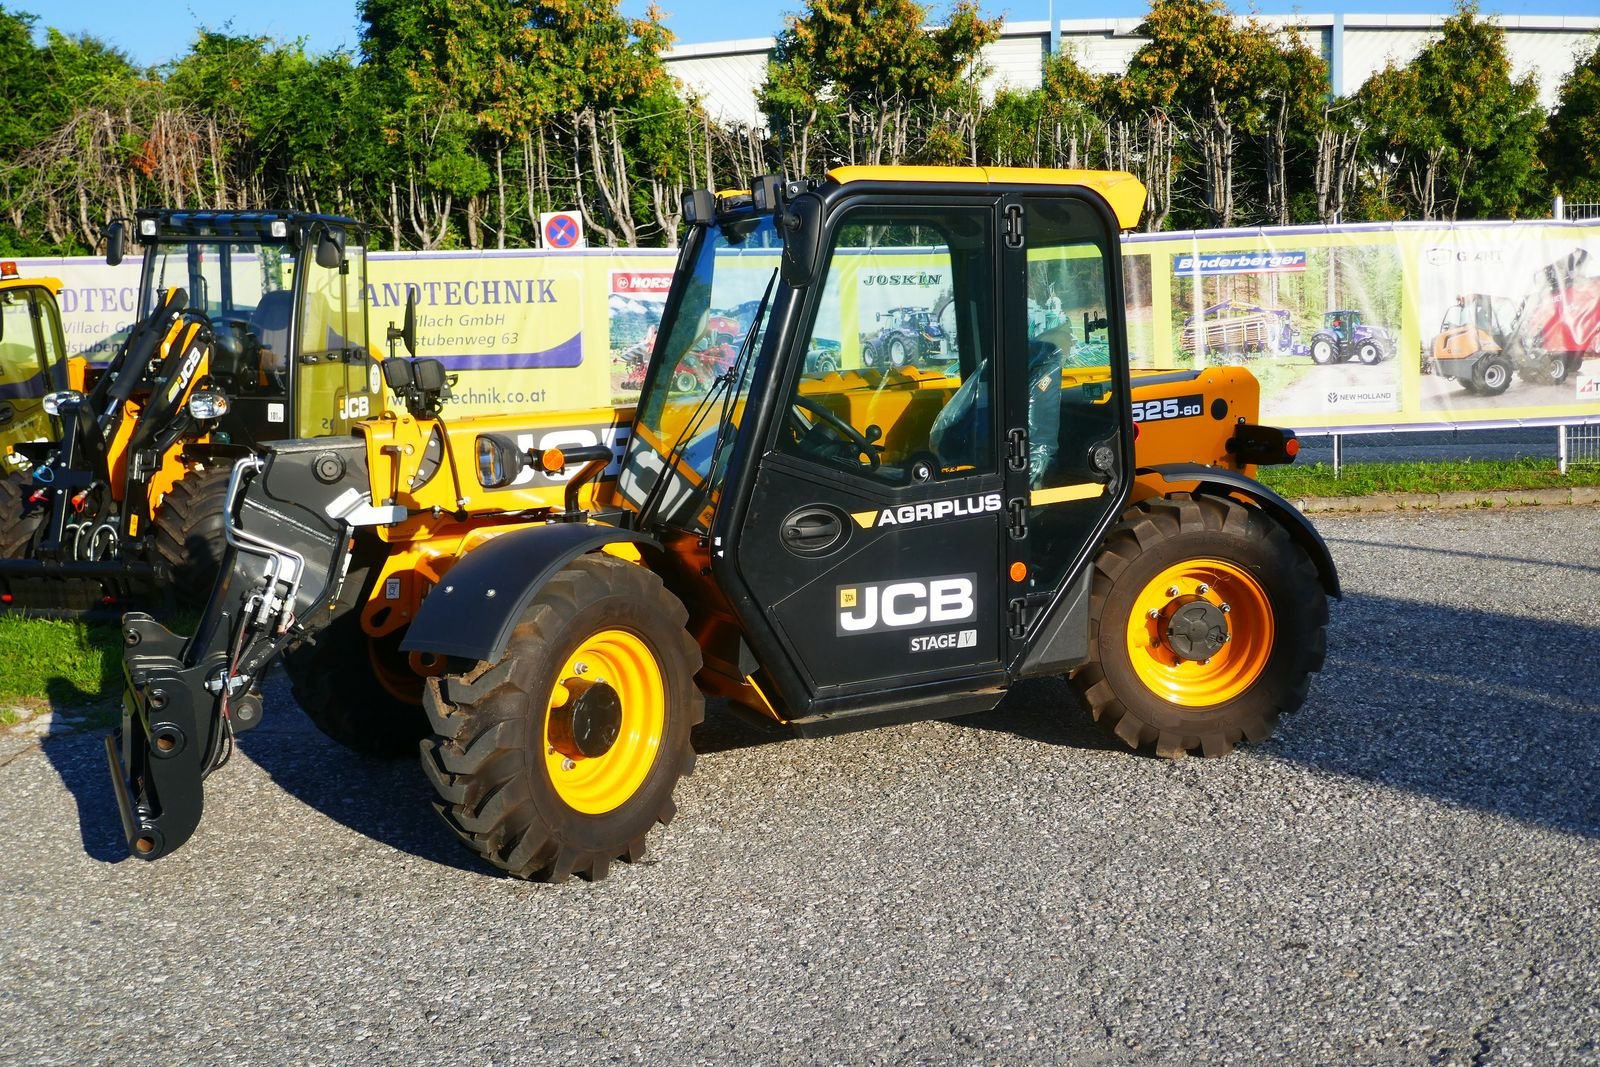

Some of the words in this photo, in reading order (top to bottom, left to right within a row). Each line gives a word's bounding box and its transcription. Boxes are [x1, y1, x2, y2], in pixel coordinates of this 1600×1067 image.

[1178, 255, 1304, 269] Binderberger
[630, 276, 672, 289] HORS
[863, 273, 942, 286] JOSKIN
[365, 278, 558, 308] ANDTECHNIK
[63, 320, 109, 334] Villach
[412, 314, 454, 329] illach
[458, 313, 506, 328] GmbH
[385, 336, 496, 349] astubenweg
[501, 332, 519, 345] 63
[180, 346, 201, 390] JCB
[1357, 392, 1392, 400] HOLLAND
[339, 394, 370, 421] JCB
[877, 494, 1002, 527] AGRIPLUS
[840, 578, 974, 631] JCB
[911, 633, 957, 652] STAGE
